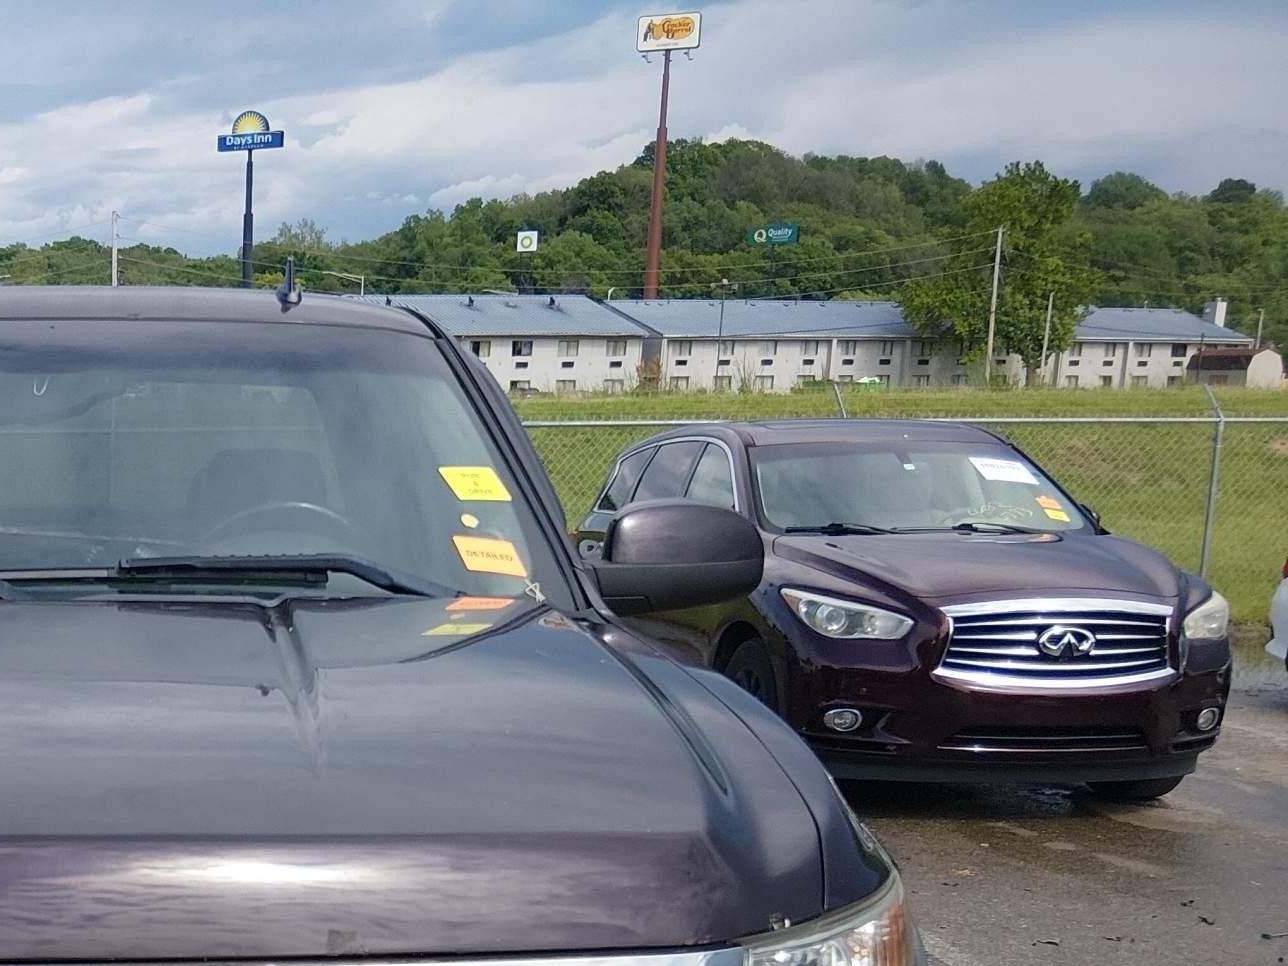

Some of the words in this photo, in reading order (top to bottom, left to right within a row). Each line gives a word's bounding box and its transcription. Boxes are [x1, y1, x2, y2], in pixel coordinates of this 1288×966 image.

[662, 20, 691, 33] Cracker
[665, 26, 691, 39] Barrel
[225, 135, 252, 146] Days
[254, 133, 272, 144] Inn
[768, 227, 793, 238] Quality
